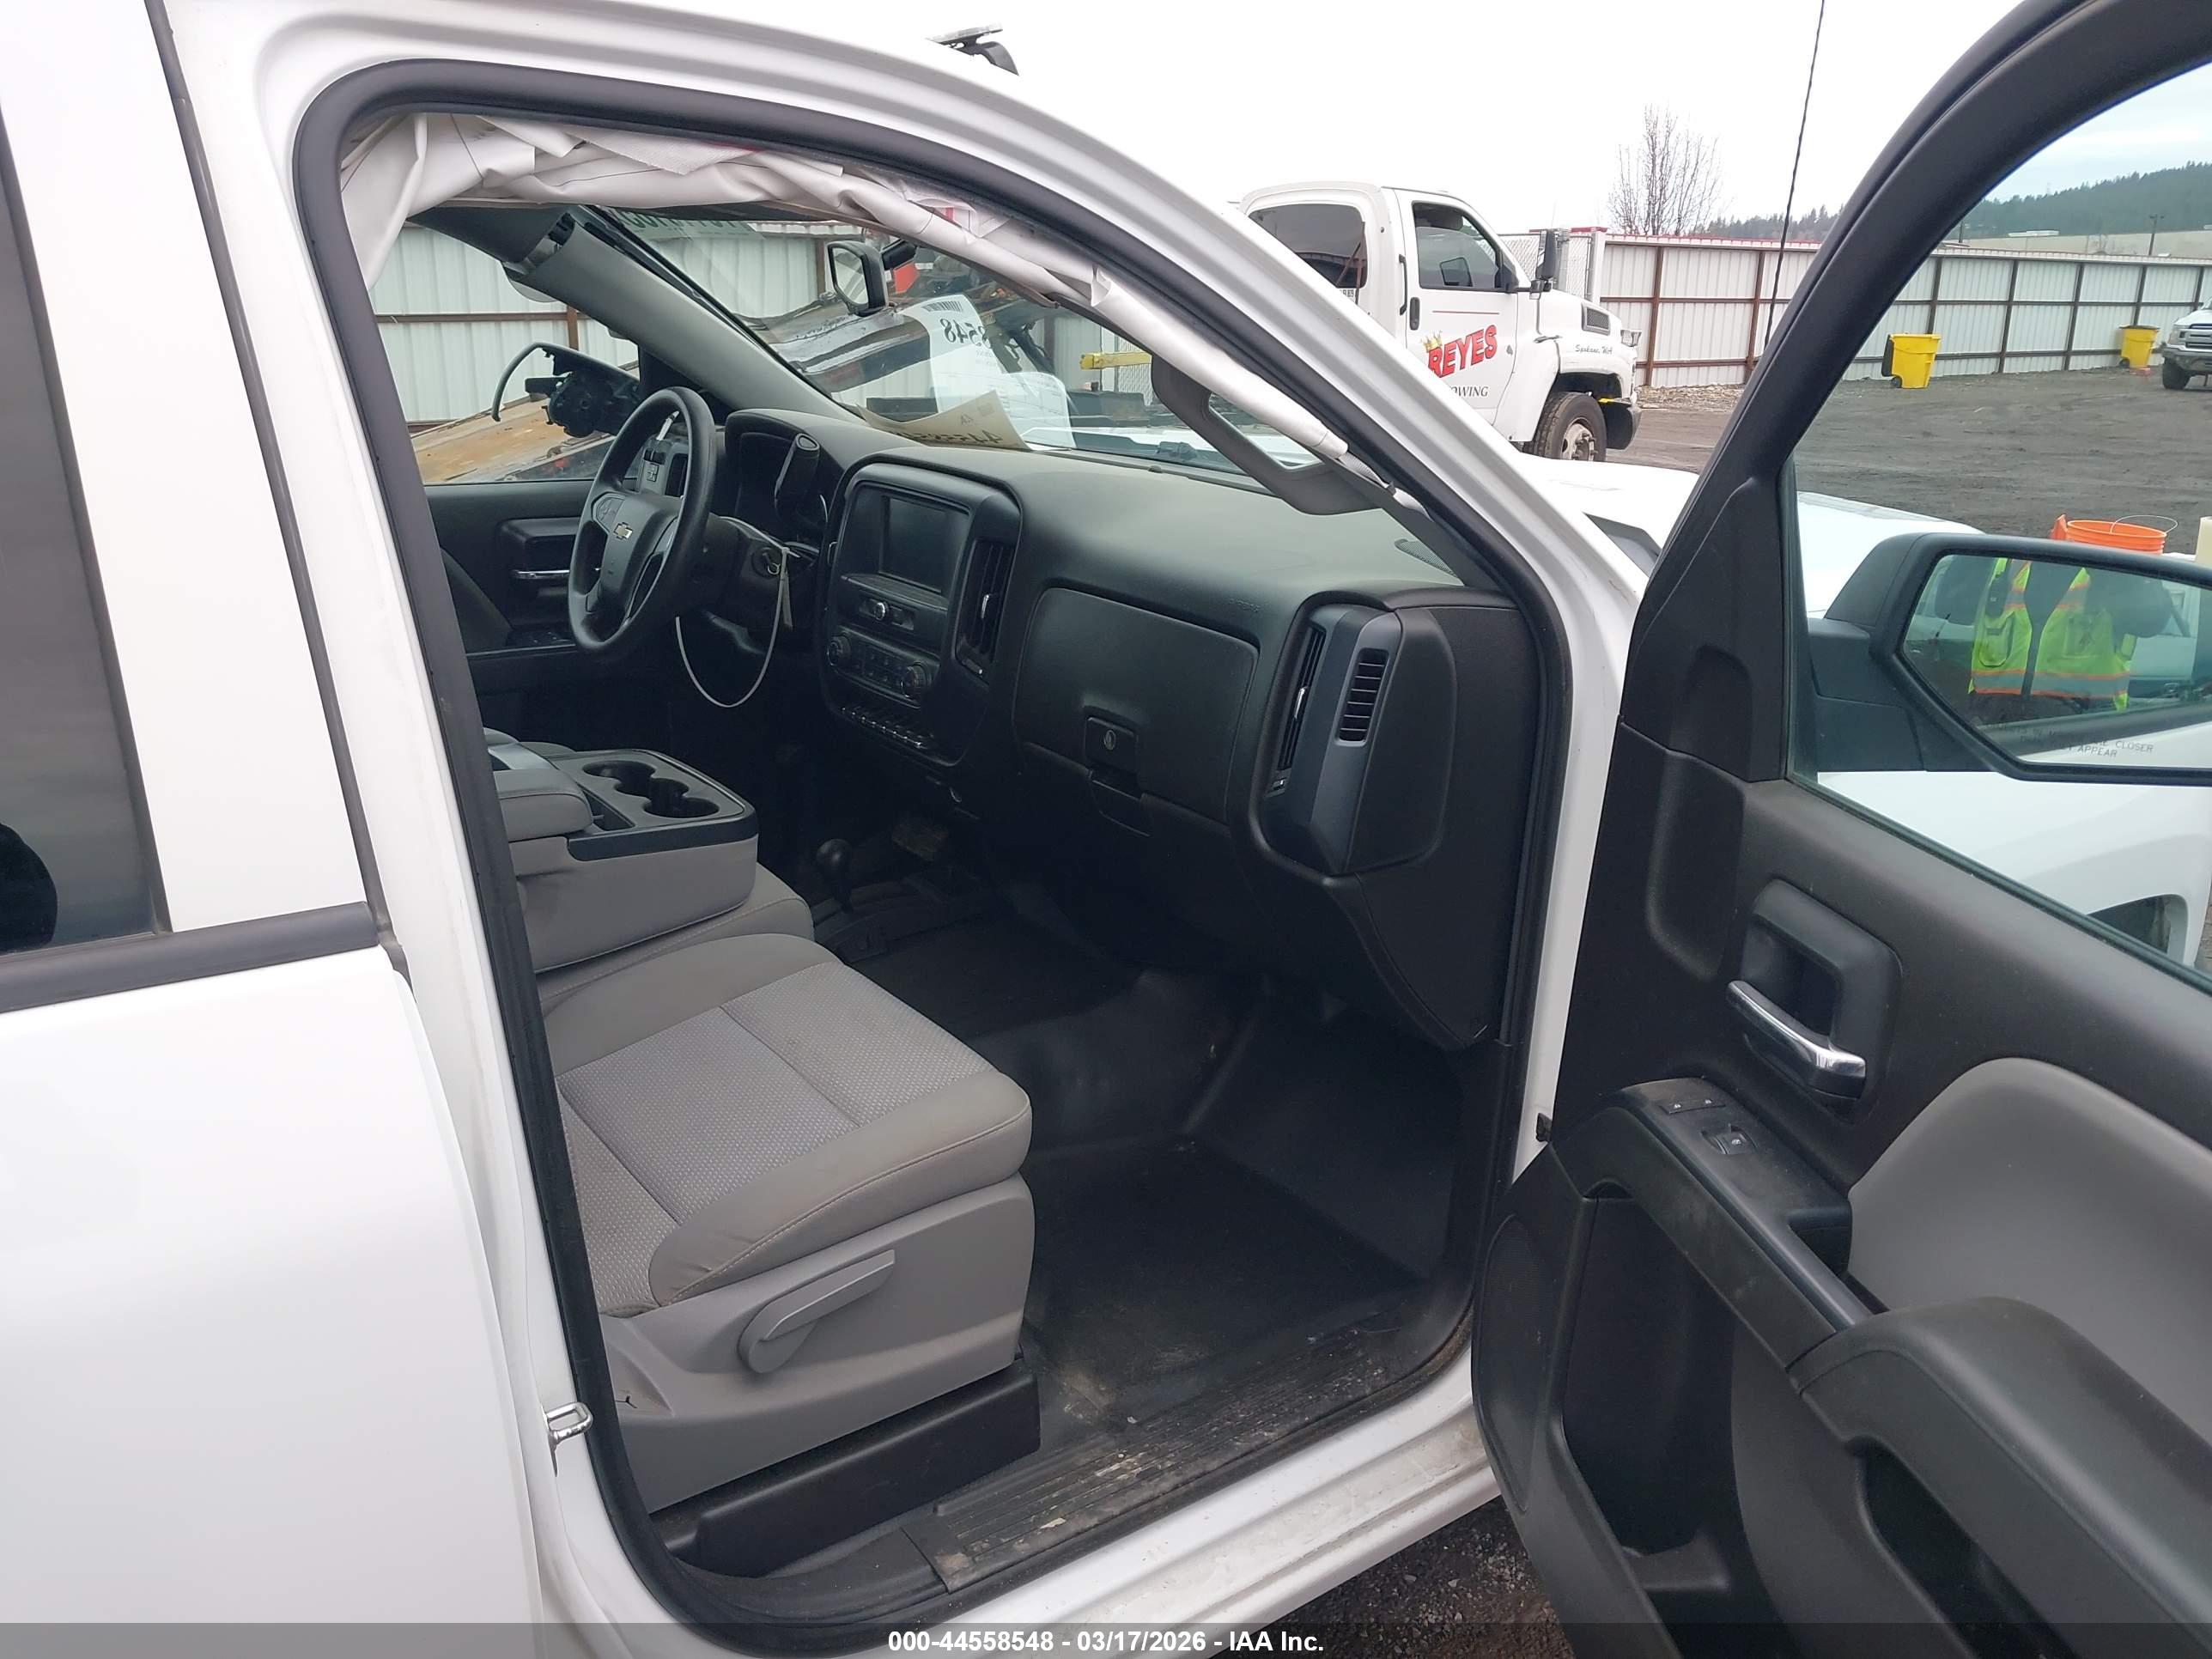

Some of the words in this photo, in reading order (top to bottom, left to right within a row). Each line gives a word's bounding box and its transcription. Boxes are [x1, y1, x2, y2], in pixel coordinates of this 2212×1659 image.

[1427, 324, 1498, 379] REYES
[1450, 386, 1489, 398] OWING
[2077, 744, 2118, 757] APPEAR
[2115, 740, 2154, 753] CLOSER
